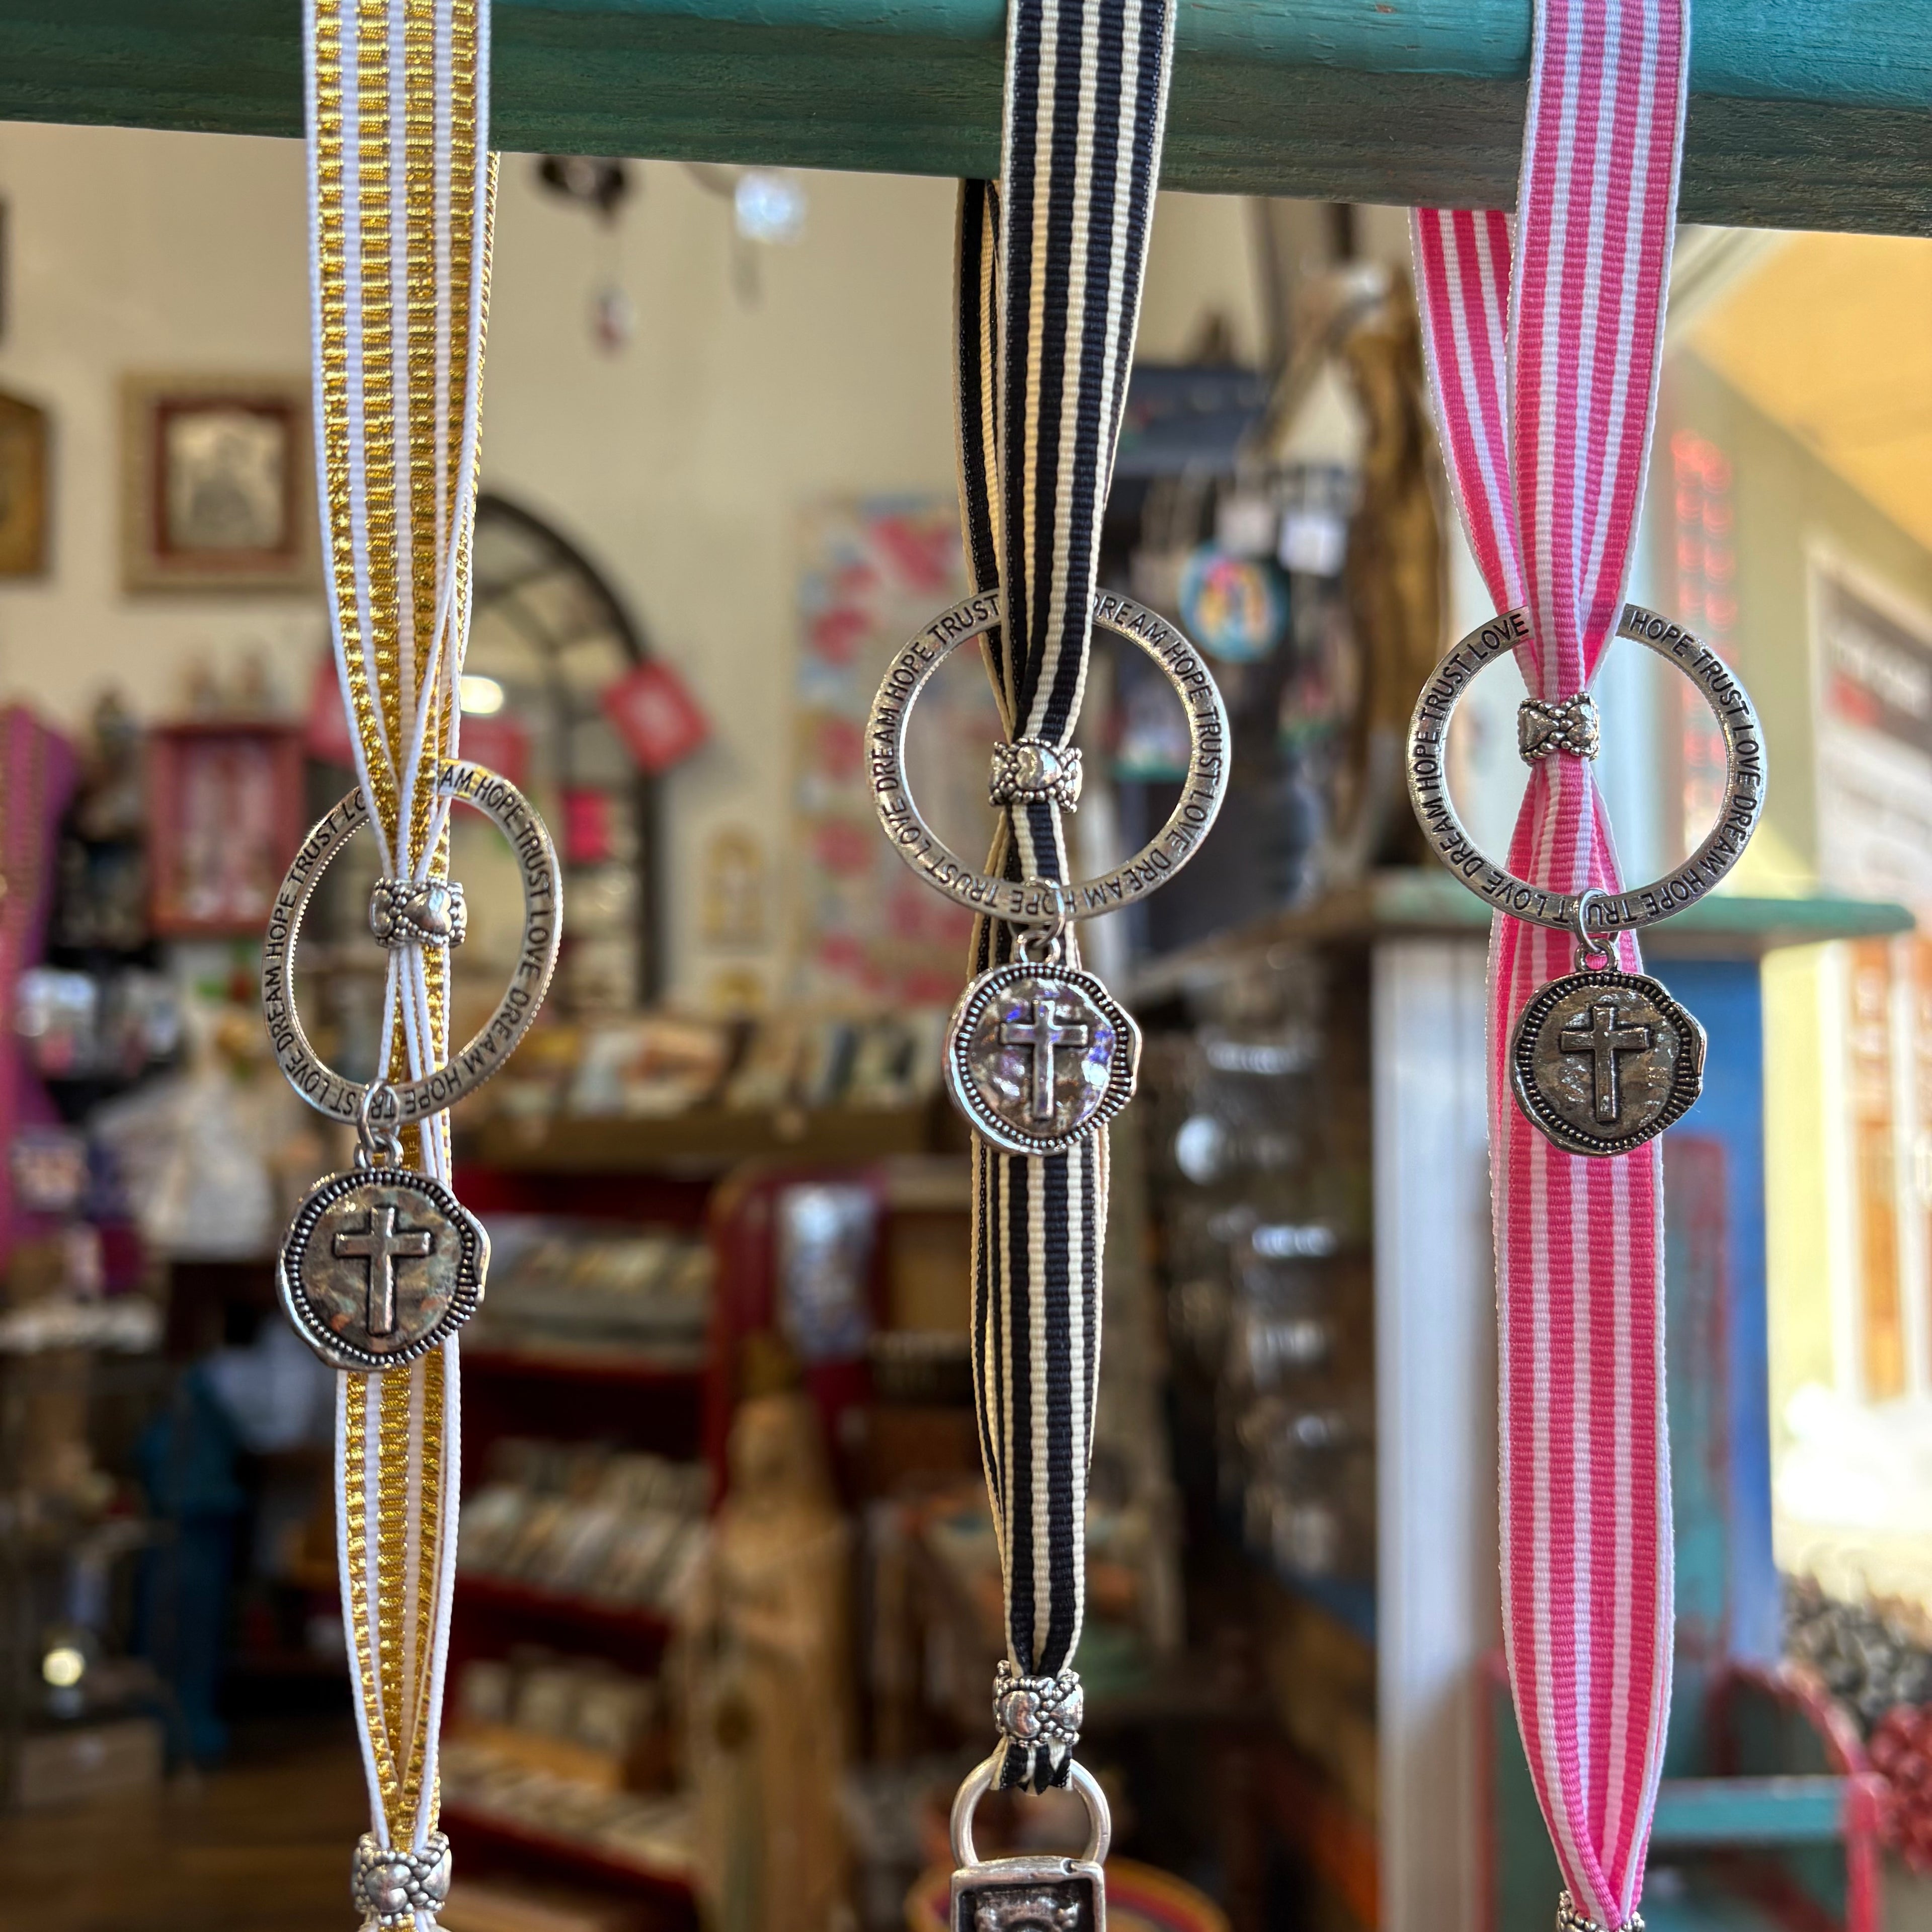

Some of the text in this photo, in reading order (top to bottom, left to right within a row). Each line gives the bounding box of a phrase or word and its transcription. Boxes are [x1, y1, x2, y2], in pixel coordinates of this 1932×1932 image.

[927, 594, 1000, 645] TRUST
[884, 641, 935, 702] HOPE
[1163, 641, 1212, 703] HOPE
[871, 707, 900, 792] DREAM
[1195, 705, 1222, 786] TRUST
[1413, 610, 1761, 926] HOPE TRUST LOVE DREAM HOPE TRUT LOVE DREAM HOPE TRUST LOVE
[474, 776, 525, 829] HOPE
[882, 797, 931, 859] LOVE
[1165, 789, 1215, 853] LOVE
[287, 813, 338, 884] TRUST
[515, 821, 551, 898] TRUST
[1083, 849, 1171, 910] DREAM
[925, 856, 998, 907] TRUST
[266, 893, 297, 957] HOPE
[519, 910, 550, 980] LOVE
[265, 965, 295, 1053] DREAM
[462, 987, 530, 1076] DREAM
[285, 1048, 330, 1102] LOVE
[330, 1088, 396, 1119] TRST
[404, 1067, 462, 1114] HOPE
